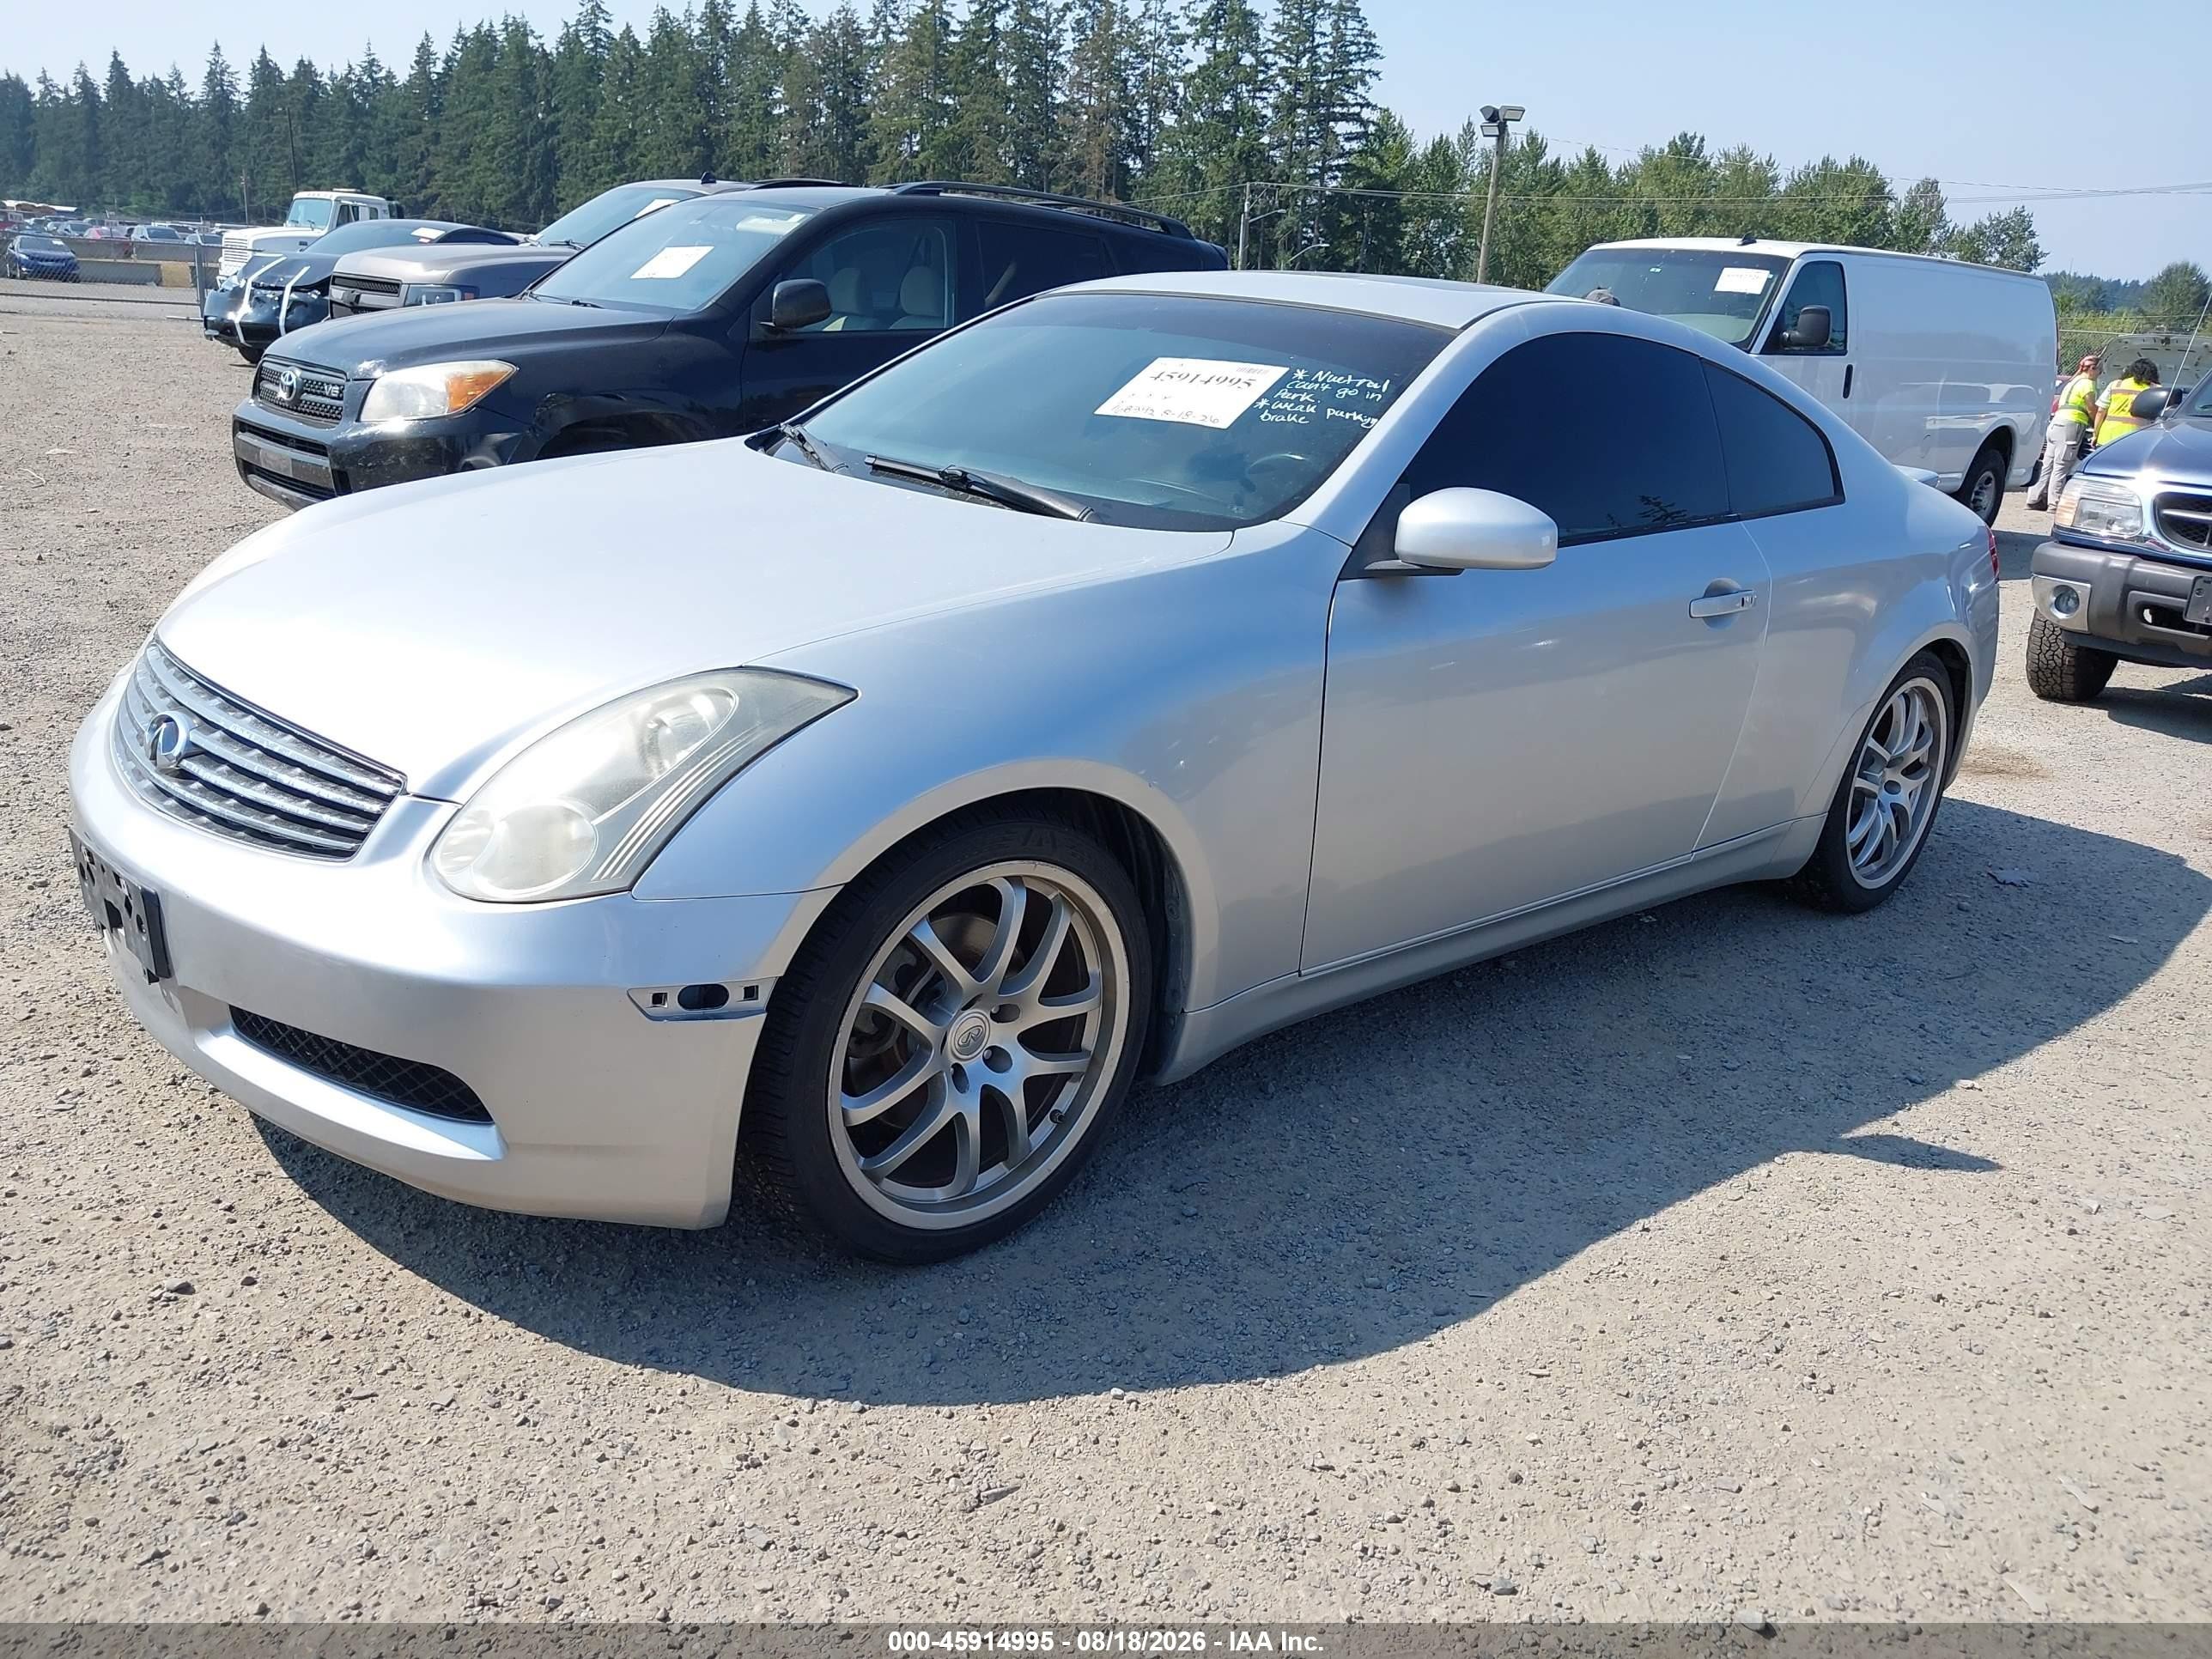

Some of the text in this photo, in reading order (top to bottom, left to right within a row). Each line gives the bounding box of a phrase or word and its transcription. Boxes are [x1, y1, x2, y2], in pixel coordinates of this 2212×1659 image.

[1149, 370, 1257, 390] 45914995
[324, 383, 340, 397] V6
[1335, 387, 1358, 398] go
[1365, 391, 1382, 403] in
[1260, 410, 1310, 424] brake
